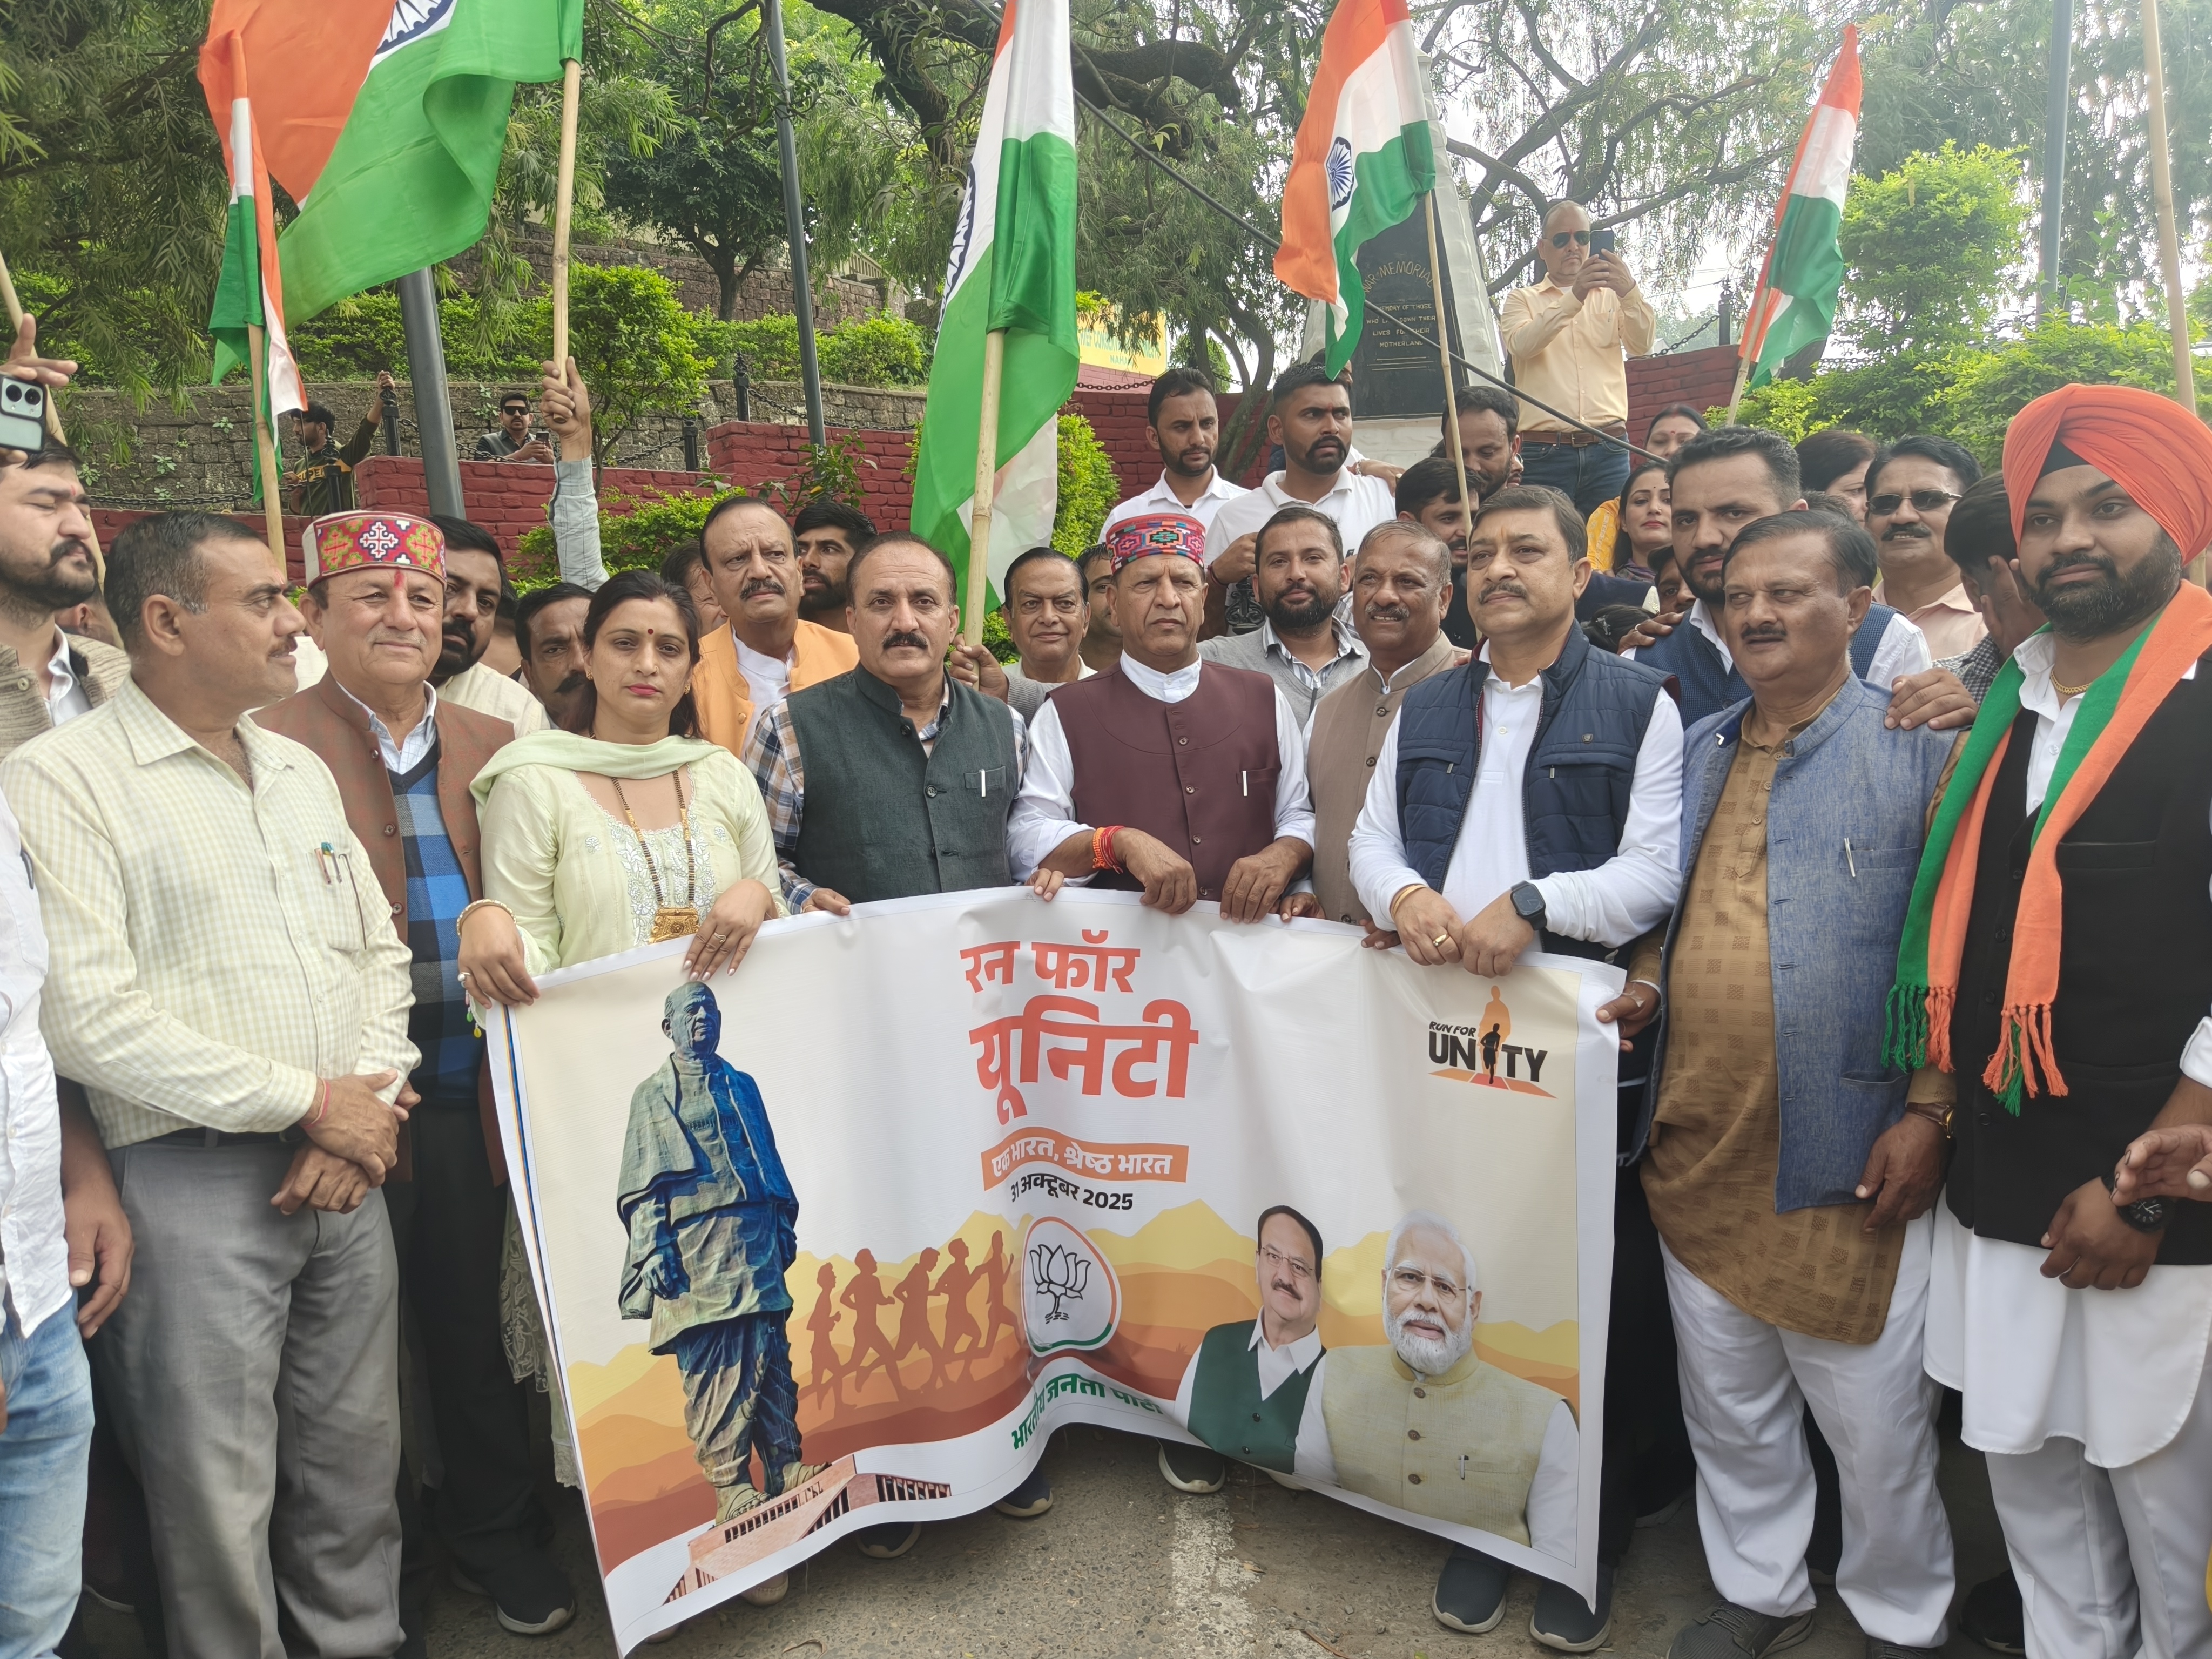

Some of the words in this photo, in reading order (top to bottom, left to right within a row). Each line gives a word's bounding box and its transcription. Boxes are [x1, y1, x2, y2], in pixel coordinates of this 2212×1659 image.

[1379, 261, 1433, 288] MEMORIAL
[1110, 354, 1133, 366] NAHA
[960, 941, 1021, 993] रन
[1031, 929, 1141, 993] फॉर
[1429, 1021, 1453, 1033] RUN
[1453, 1026, 1476, 1037] FOR
[969, 994, 1199, 1125] यूनिटी
[991, 1147, 1010, 1177] एक
[1010, 1137, 1059, 1161] भारत,
[1064, 1141, 1114, 1174] श्रेष्ठ
[1118, 1154, 1173, 1174] भारत
[1011, 1182, 1019, 1203] 31
[1020, 1173, 1080, 1201] अक्टूबर
[1082, 1189, 1134, 1210] 2025
[1011, 1386, 1045, 1450] भारतीय
[1046, 1373, 1105, 1403] जनता
